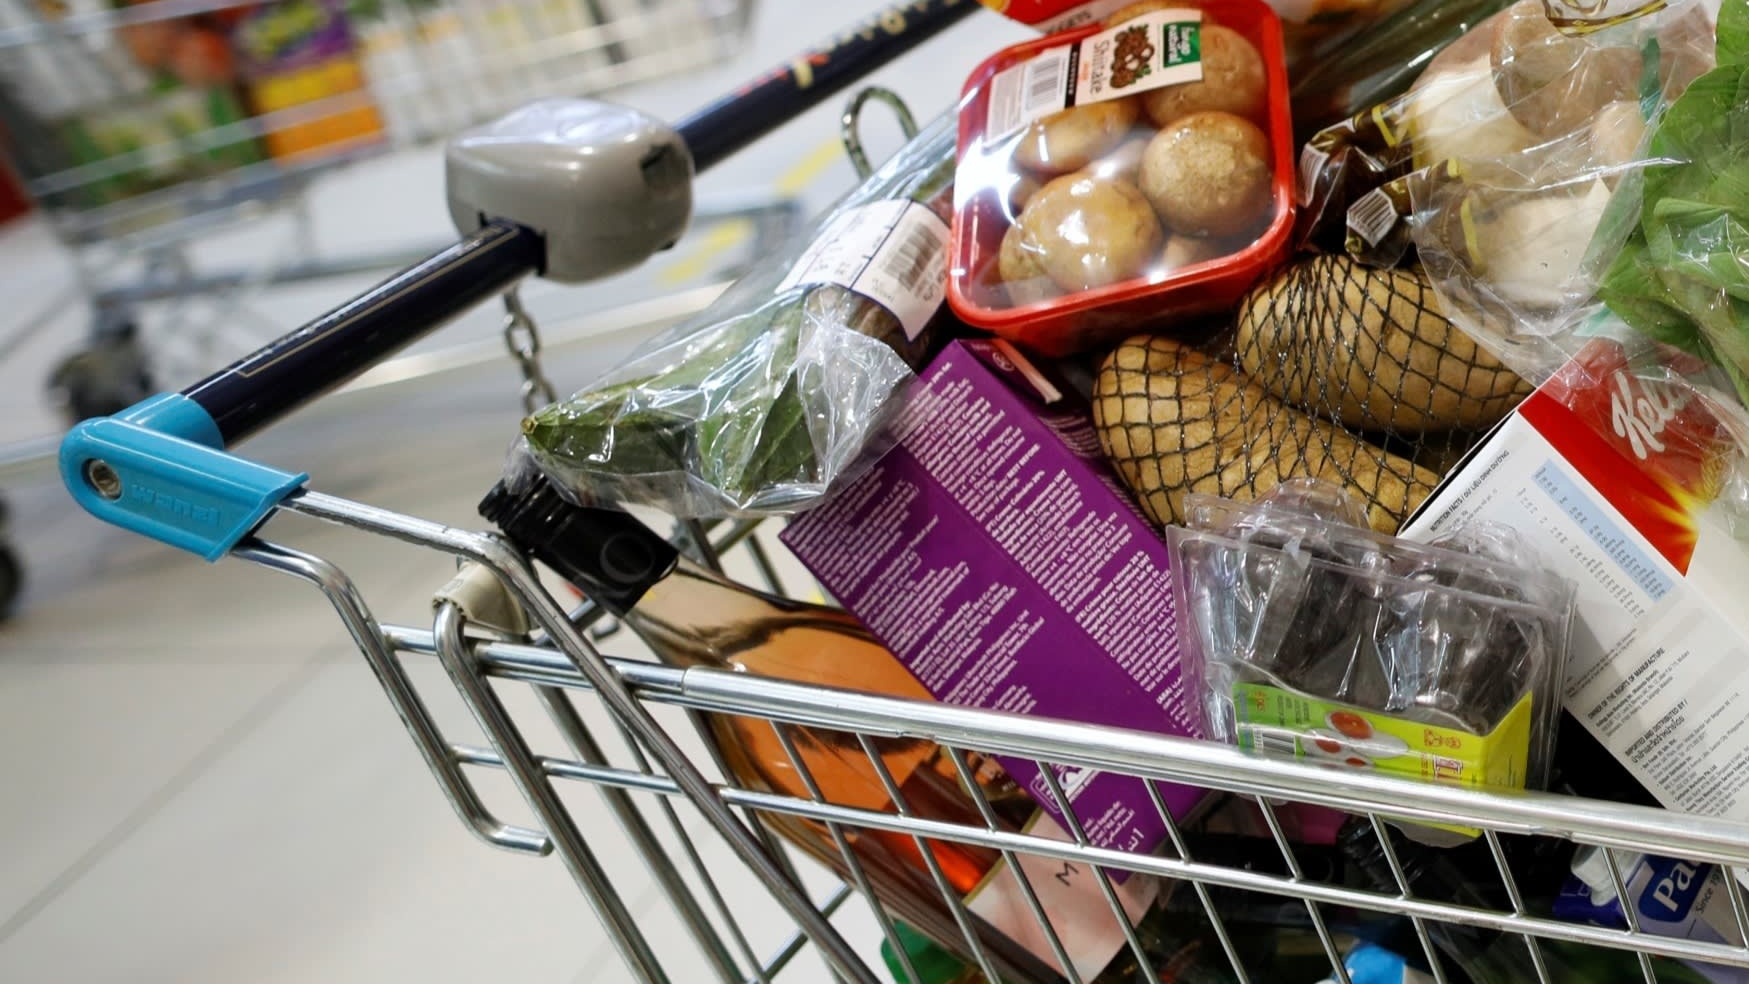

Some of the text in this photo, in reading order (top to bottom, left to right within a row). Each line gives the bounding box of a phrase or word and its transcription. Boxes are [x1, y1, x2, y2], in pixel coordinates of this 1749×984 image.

[1006, 463, 1020, 478] BEST
[1587, 647, 1663, 719] OWNER OF THE RIGHTS OF MANUFACTURE
[1624, 737, 1645, 756] IMPORTED
[1643, 729, 1654, 739] AND
[1652, 707, 1678, 732] DISTRIBUTED
[1676, 701, 1685, 709] BY
[1695, 885, 1717, 916] Since
